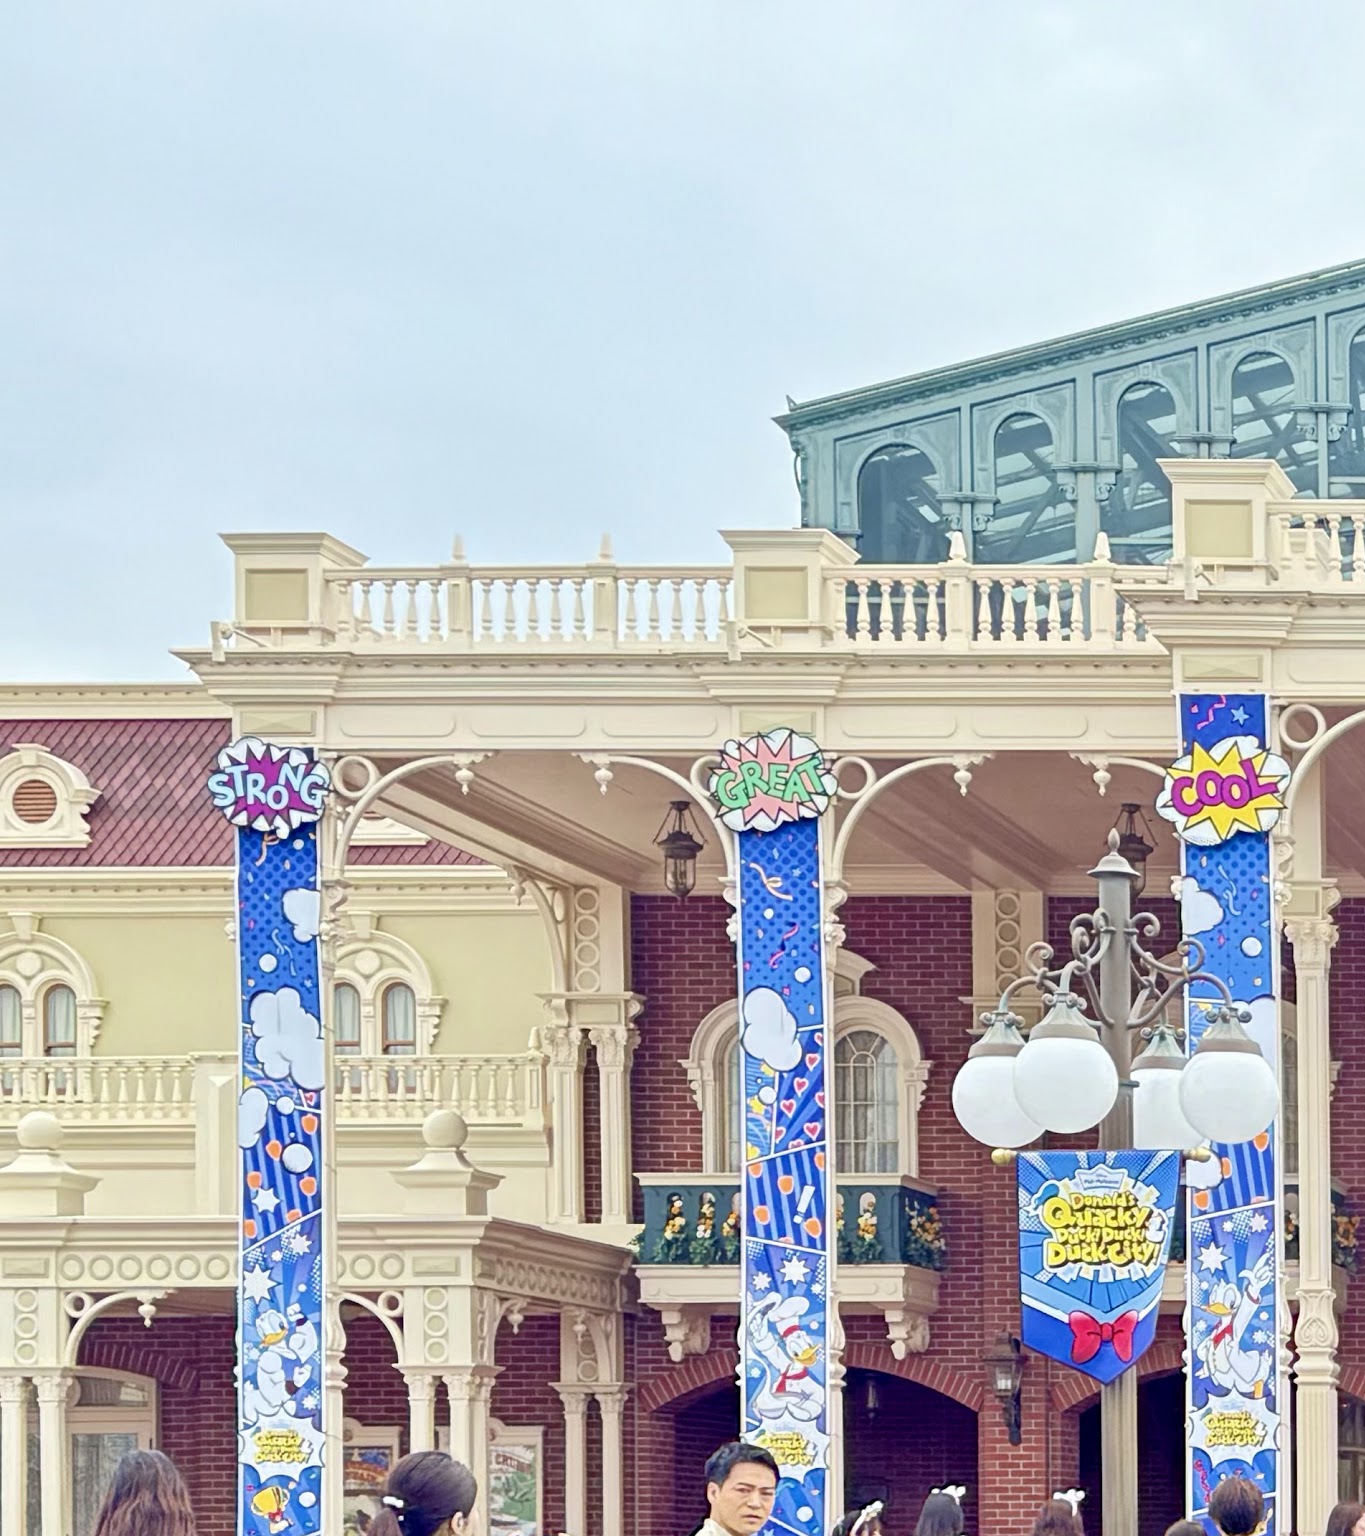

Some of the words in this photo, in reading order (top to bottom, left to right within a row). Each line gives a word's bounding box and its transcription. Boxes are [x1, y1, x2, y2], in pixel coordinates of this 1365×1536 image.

[207, 761, 329, 810] STRONG
[716, 756, 826, 810] GREAT
[1171, 758, 1280, 817] COOL
[1042, 1196, 1153, 1229] Quacky
[1070, 1191, 1136, 1210] Donald's
[1046, 1241, 1108, 1268] Duck
[1107, 1240, 1162, 1267] City!
